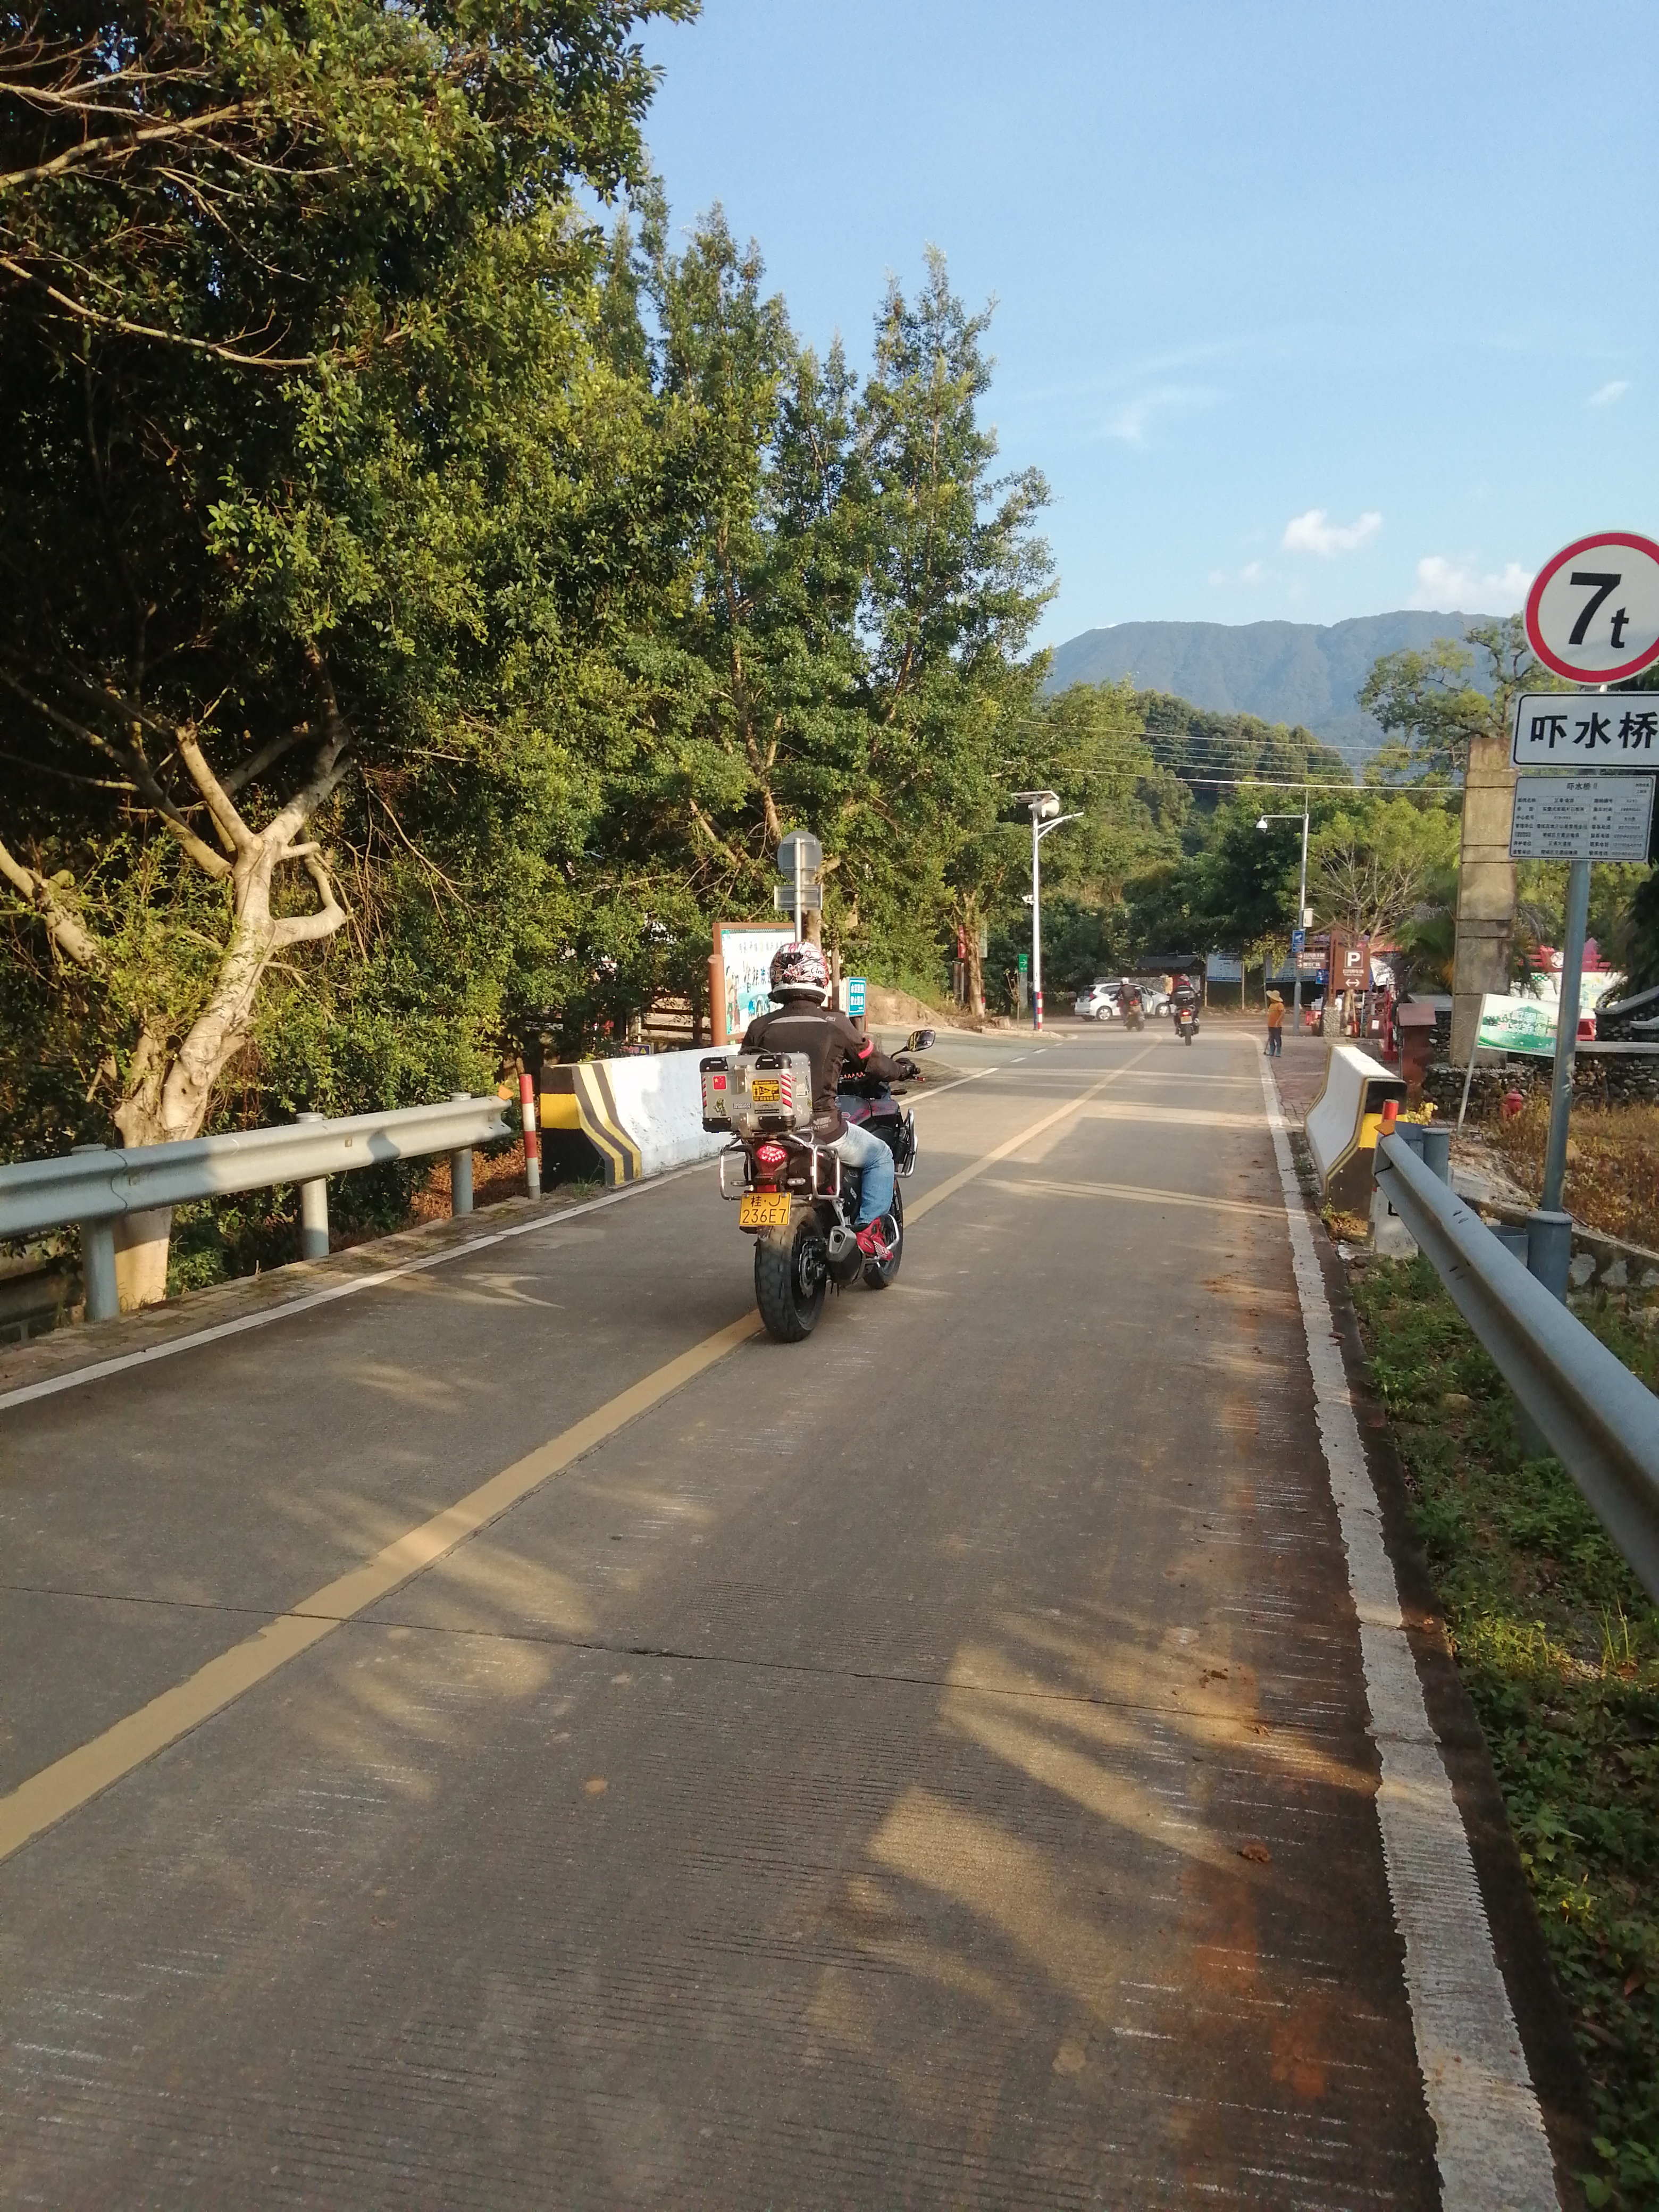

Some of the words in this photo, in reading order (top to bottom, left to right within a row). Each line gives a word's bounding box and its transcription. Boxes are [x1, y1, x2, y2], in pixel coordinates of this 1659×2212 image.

[1530, 711, 1658, 749] 吓水桥
[1566, 782, 1591, 790] 吓水桥
[1347, 952, 1361, 967] P
[751, 1195, 781, 1207] 桂·J
[742, 1209, 786, 1223] 236E7
